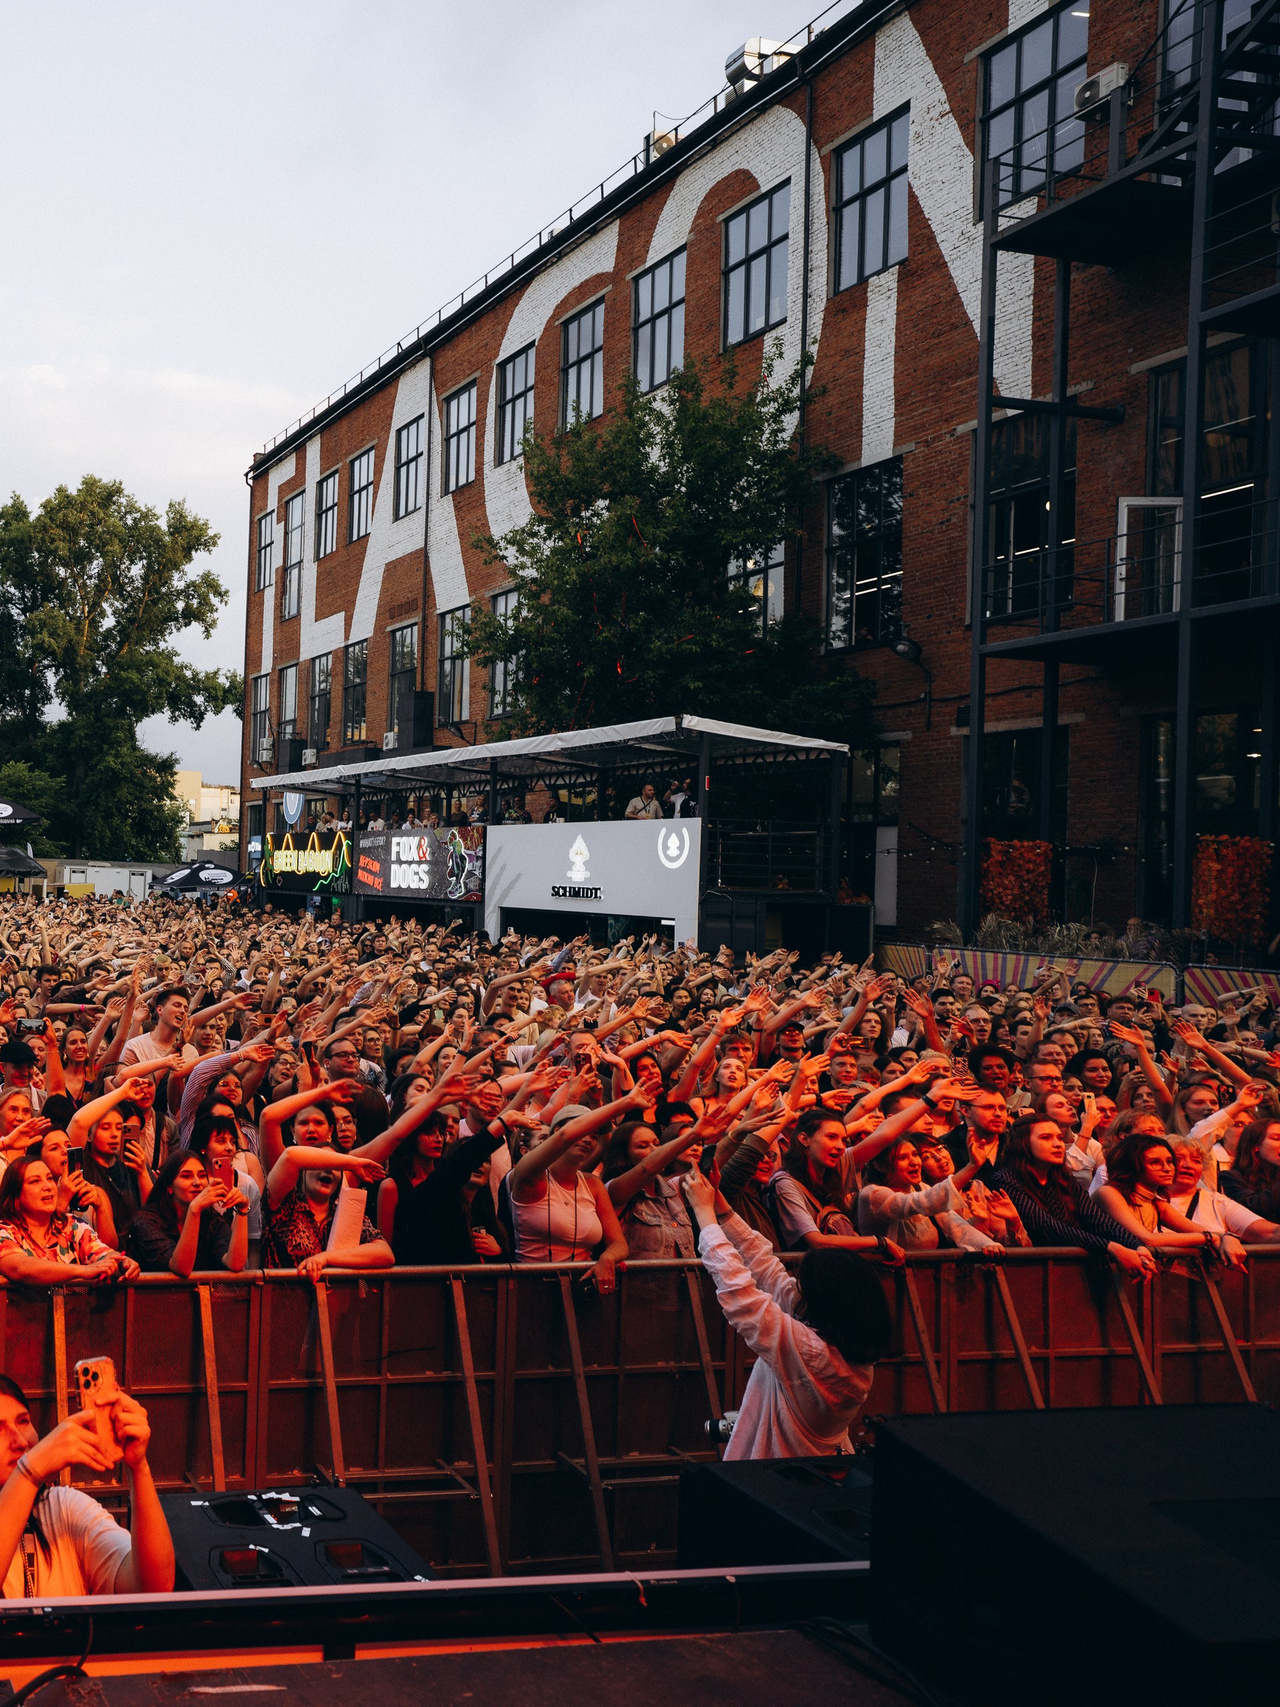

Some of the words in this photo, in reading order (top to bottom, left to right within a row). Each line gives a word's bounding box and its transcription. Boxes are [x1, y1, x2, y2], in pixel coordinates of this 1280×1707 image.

[261, 0, 1048, 673] FLACON
[391, 836, 430, 861] FOX&
[274, 850, 298, 872] GREEN
[298, 850, 333, 873] BABOON
[390, 863, 429, 889] DOGS
